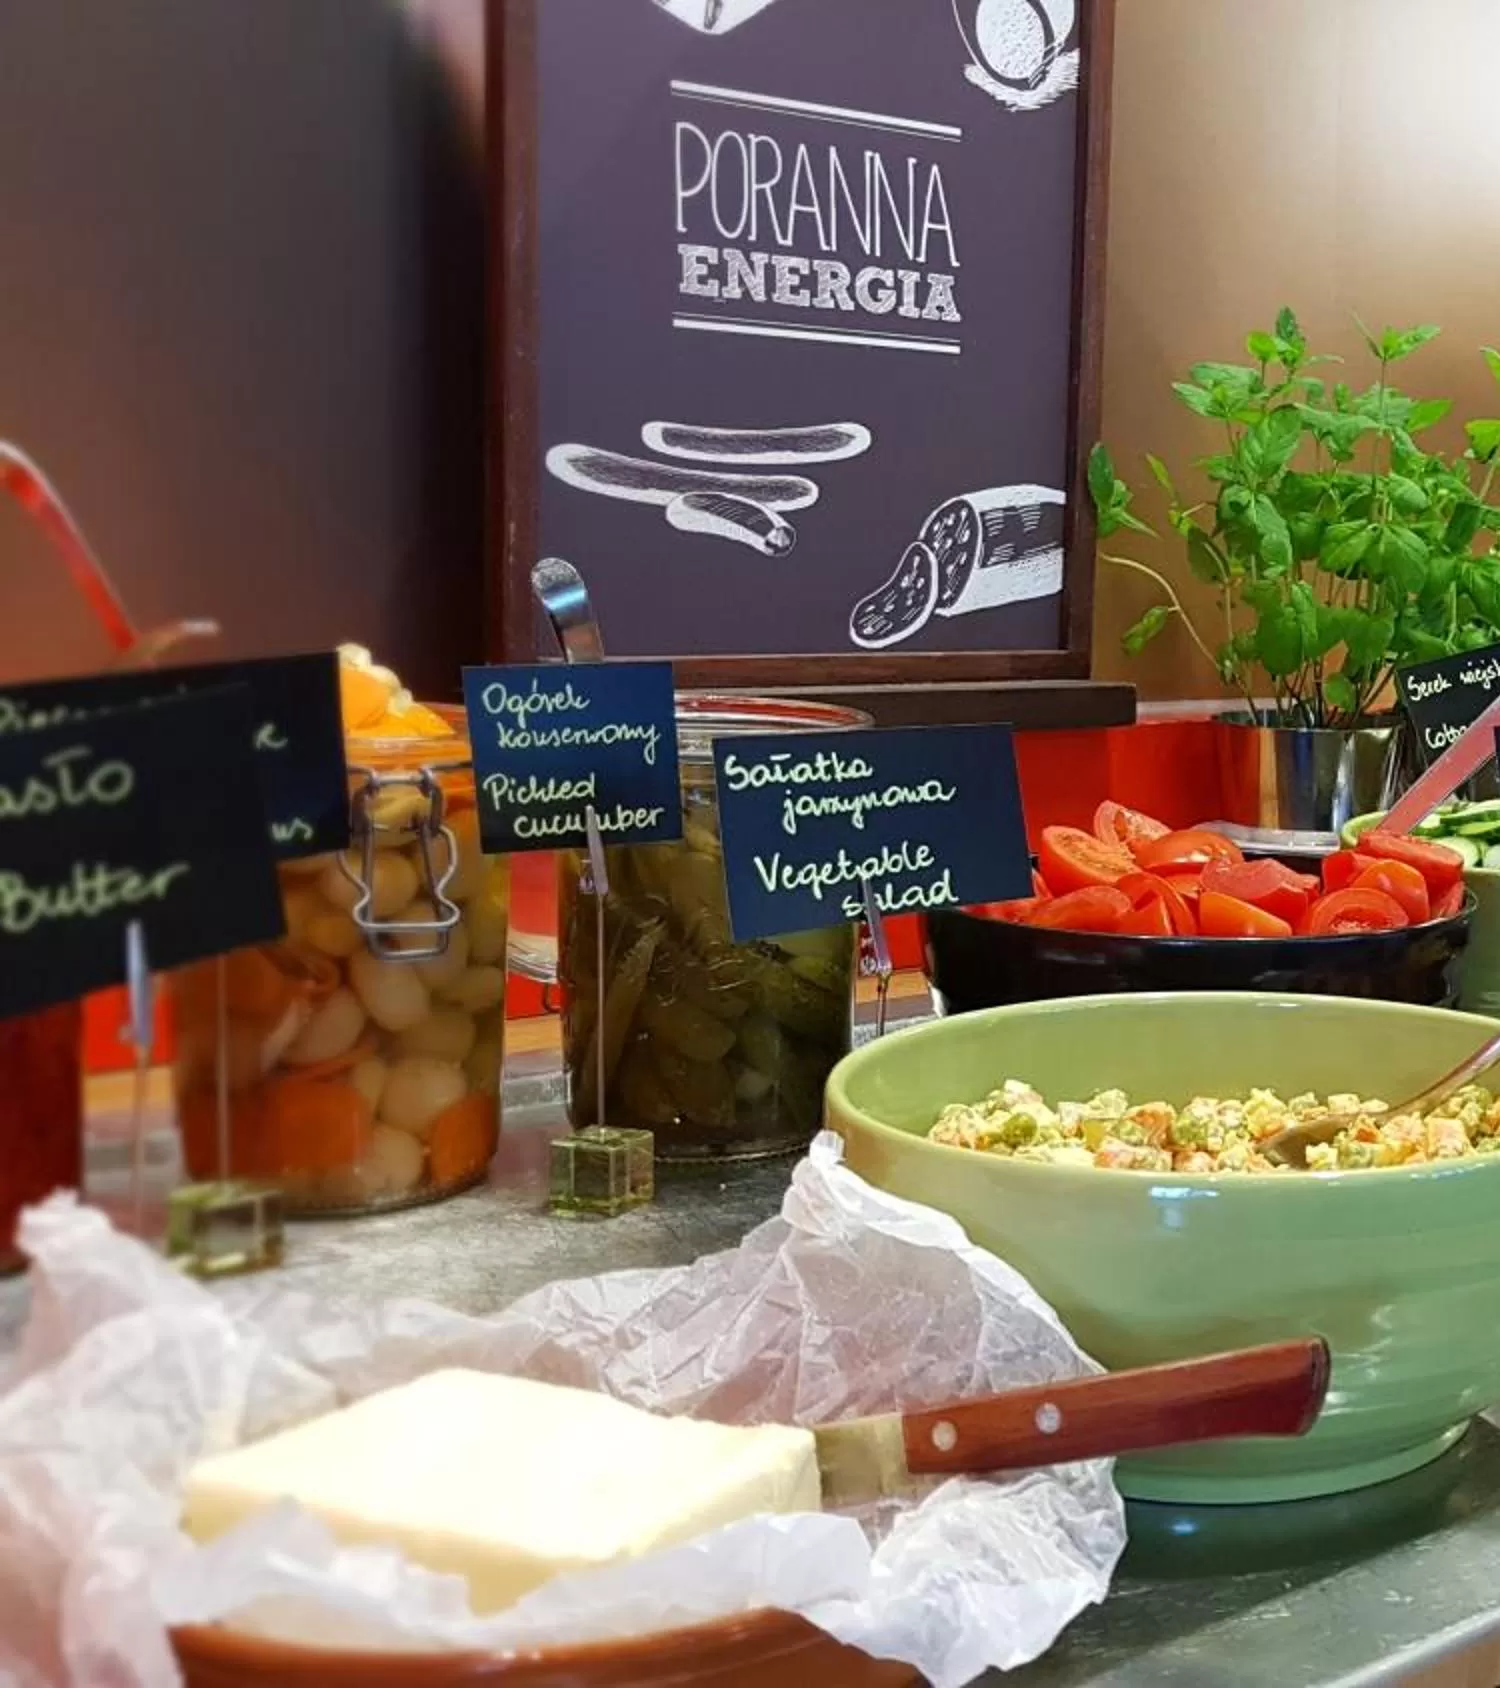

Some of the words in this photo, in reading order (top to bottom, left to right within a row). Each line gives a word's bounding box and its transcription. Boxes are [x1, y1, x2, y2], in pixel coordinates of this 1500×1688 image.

[674, 121, 960, 267] PORANNA
[677, 243, 961, 322] ENERGIA
[481, 677, 590, 729] Ogórek
[1407, 671, 1452, 701] Serek
[0, 744, 135, 819] asło
[482, 771, 596, 811] Pickled
[723, 752, 873, 791] Sałatka
[780, 779, 956, 834] jarzynowa
[753, 840, 935, 900] Vegetable
